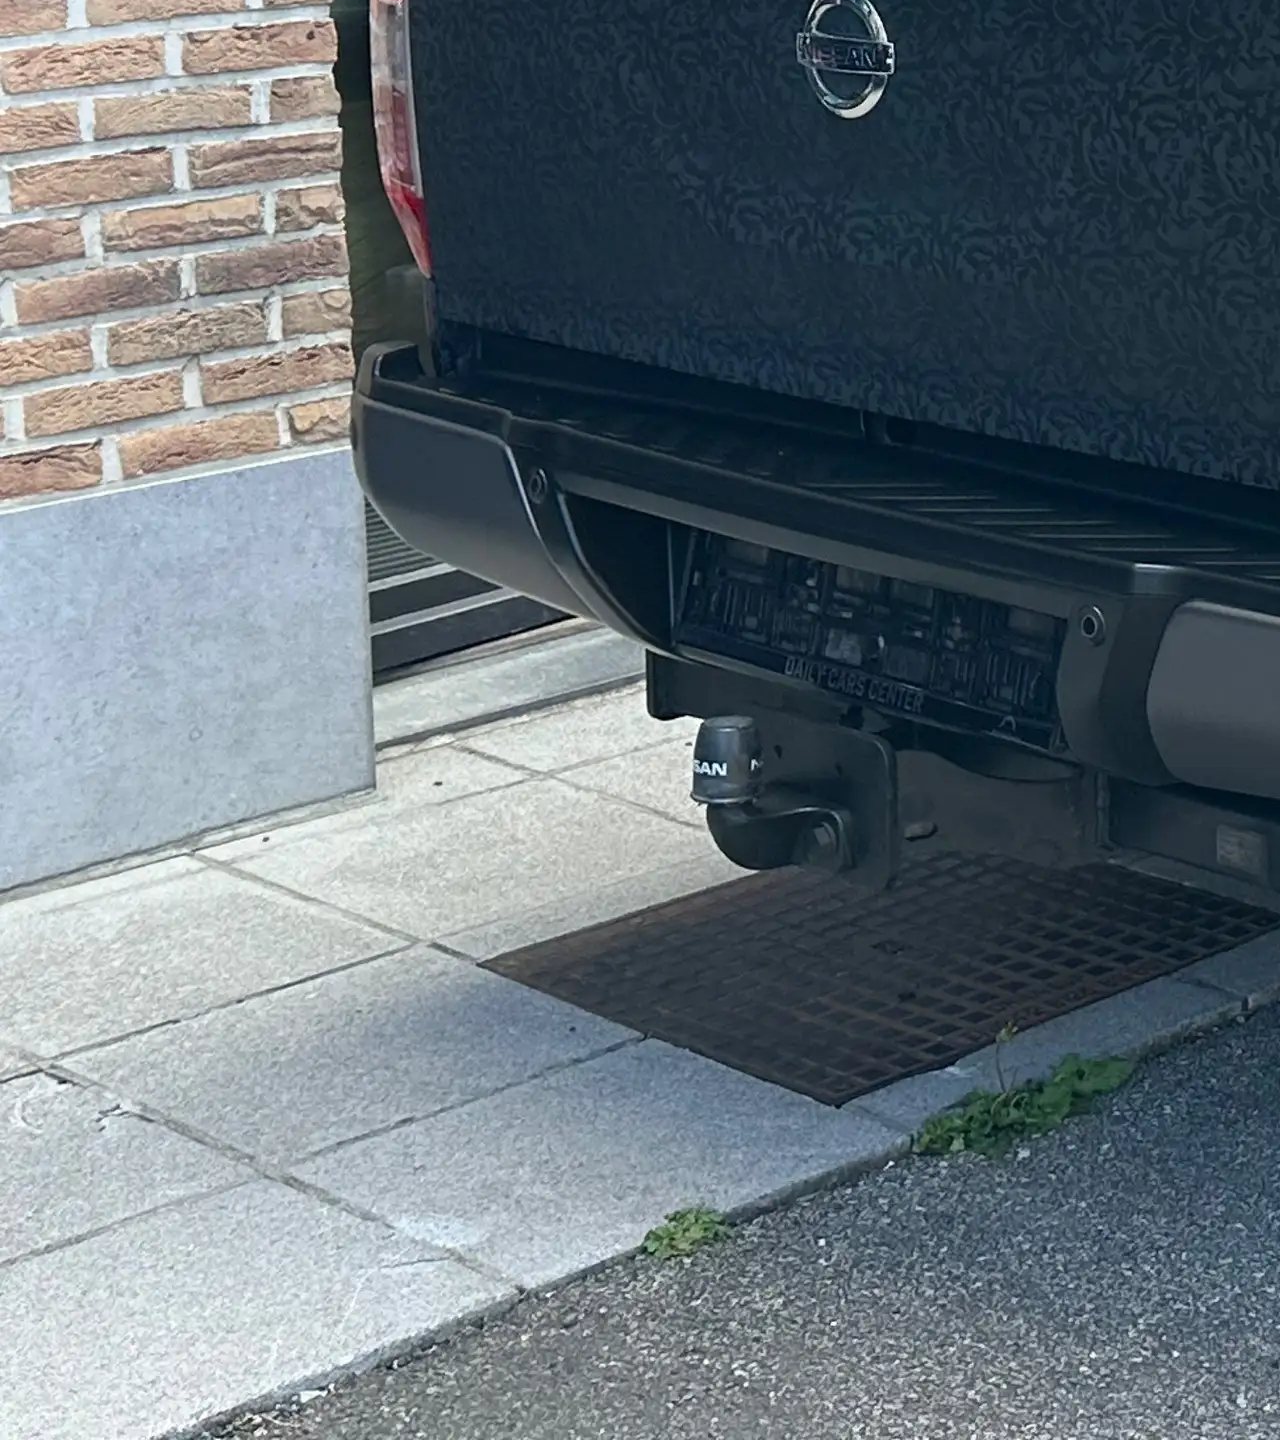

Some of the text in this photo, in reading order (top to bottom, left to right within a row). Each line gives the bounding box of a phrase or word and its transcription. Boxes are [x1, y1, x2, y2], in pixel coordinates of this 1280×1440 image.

[784, 655, 925, 714] DAILY CARS CENTER
